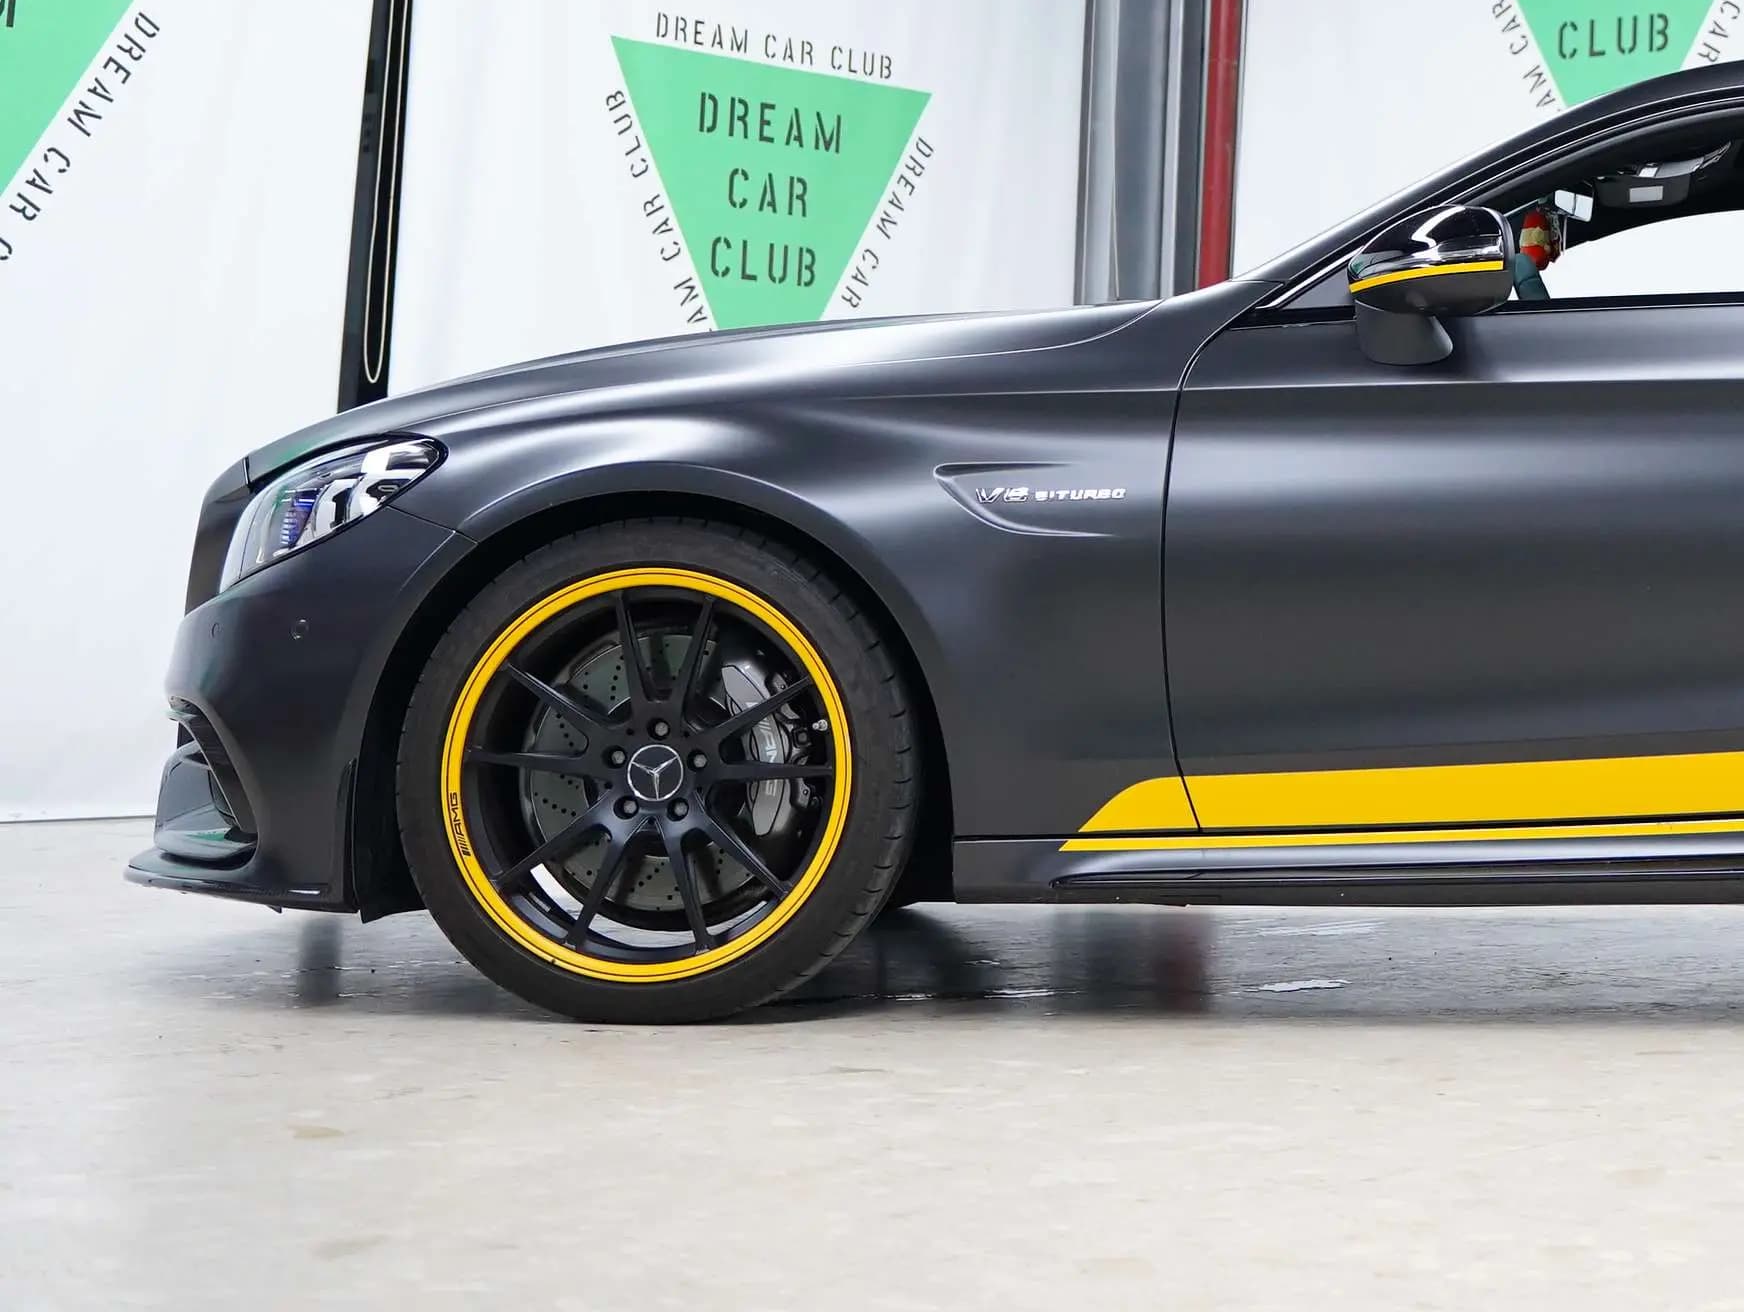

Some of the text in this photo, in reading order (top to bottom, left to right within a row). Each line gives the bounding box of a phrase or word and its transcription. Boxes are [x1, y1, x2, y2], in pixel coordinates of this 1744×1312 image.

[656, 12, 892, 79] DREAM CAR CLUB
[1558, 13, 1669, 60] CLUB
[1697, 1, 1740, 63] CAR
[9, 12, 160, 221] DREAM CAR
[698, 91, 841, 154] DREAM
[605, 89, 681, 262] CAR CLUB
[728, 167, 808, 218] CAR
[841, 136, 934, 309] DREAM CAR
[710, 236, 816, 287] CLUB
